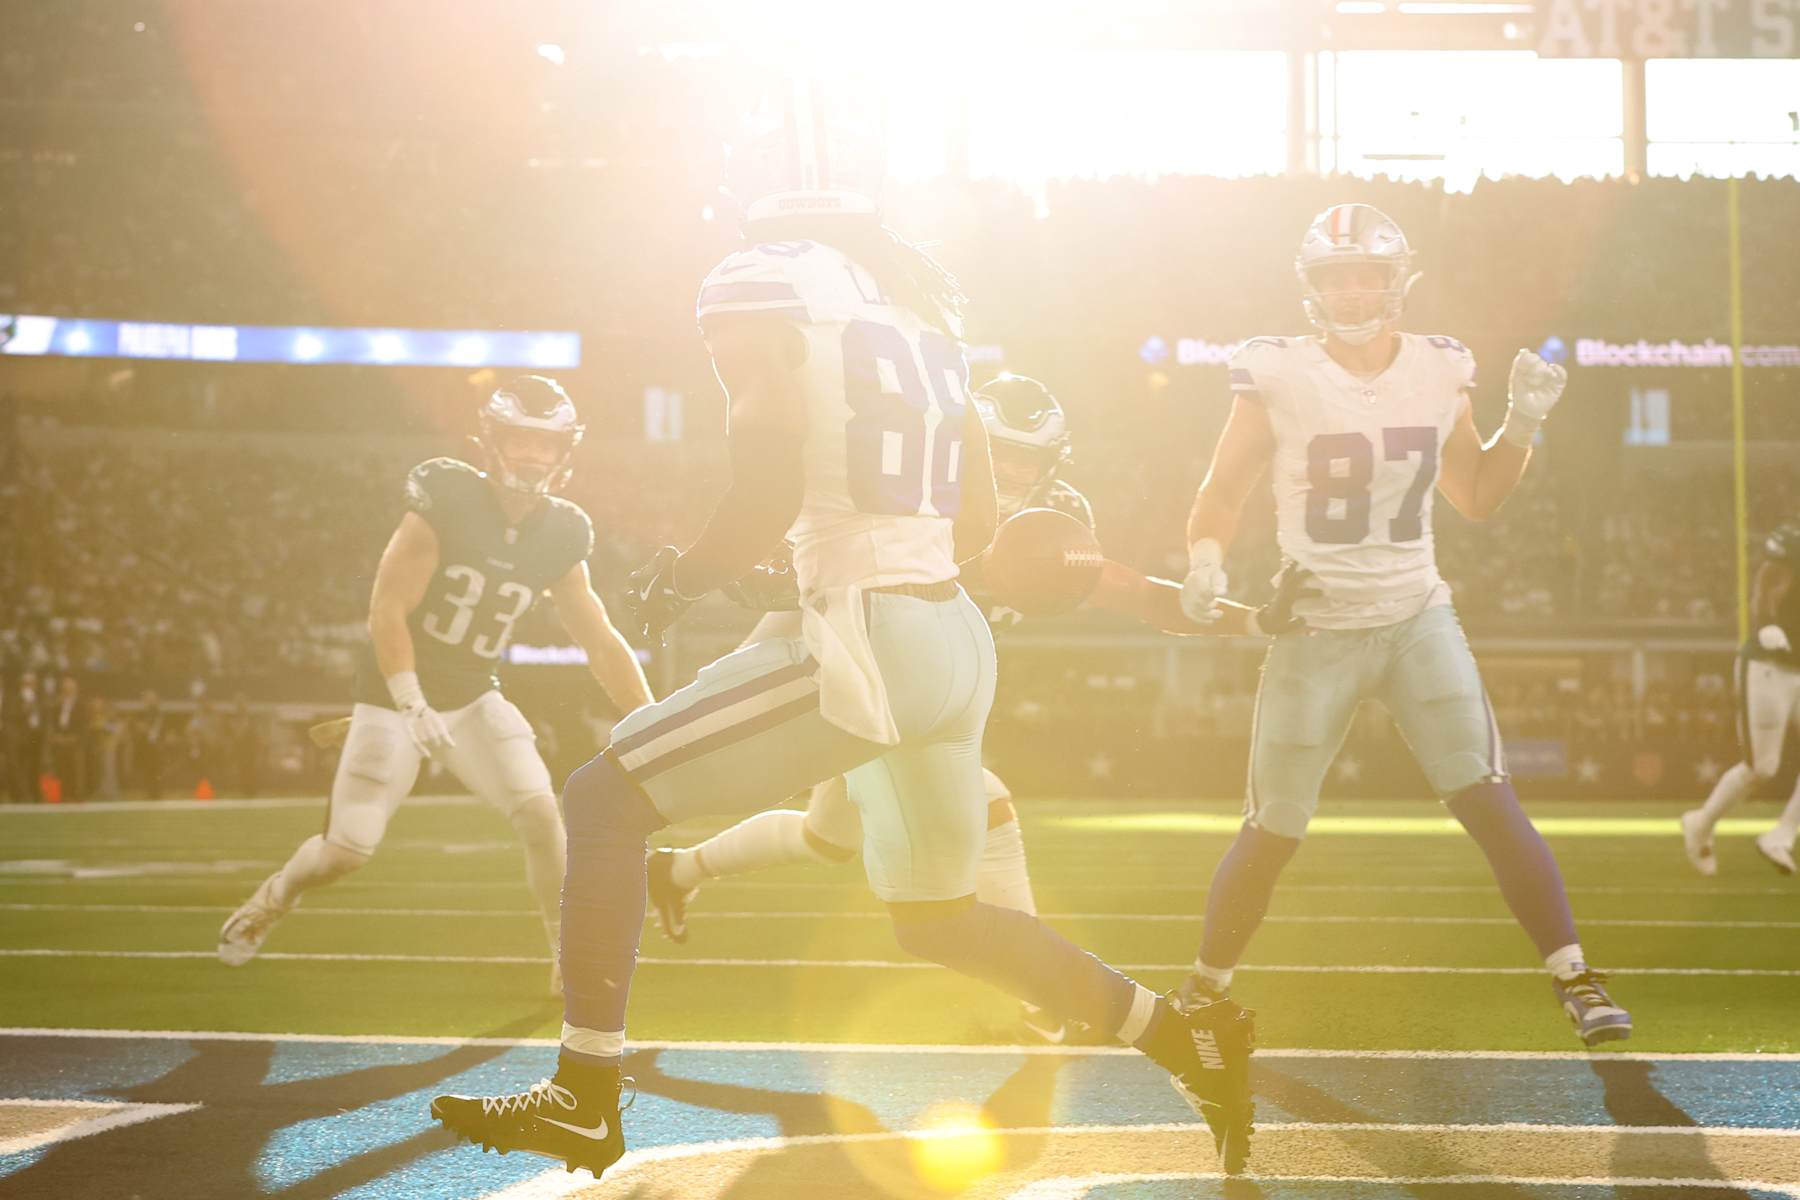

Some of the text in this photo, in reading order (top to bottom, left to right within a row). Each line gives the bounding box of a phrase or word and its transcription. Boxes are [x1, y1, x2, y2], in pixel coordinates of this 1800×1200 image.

[1537, 0, 1800, 55] AT&T S
[1576, 337, 1800, 367] Blockchaincom
[1305, 426, 1438, 544] 87
[422, 563, 533, 658] 33
[1191, 1028, 1225, 1070] NIKE
